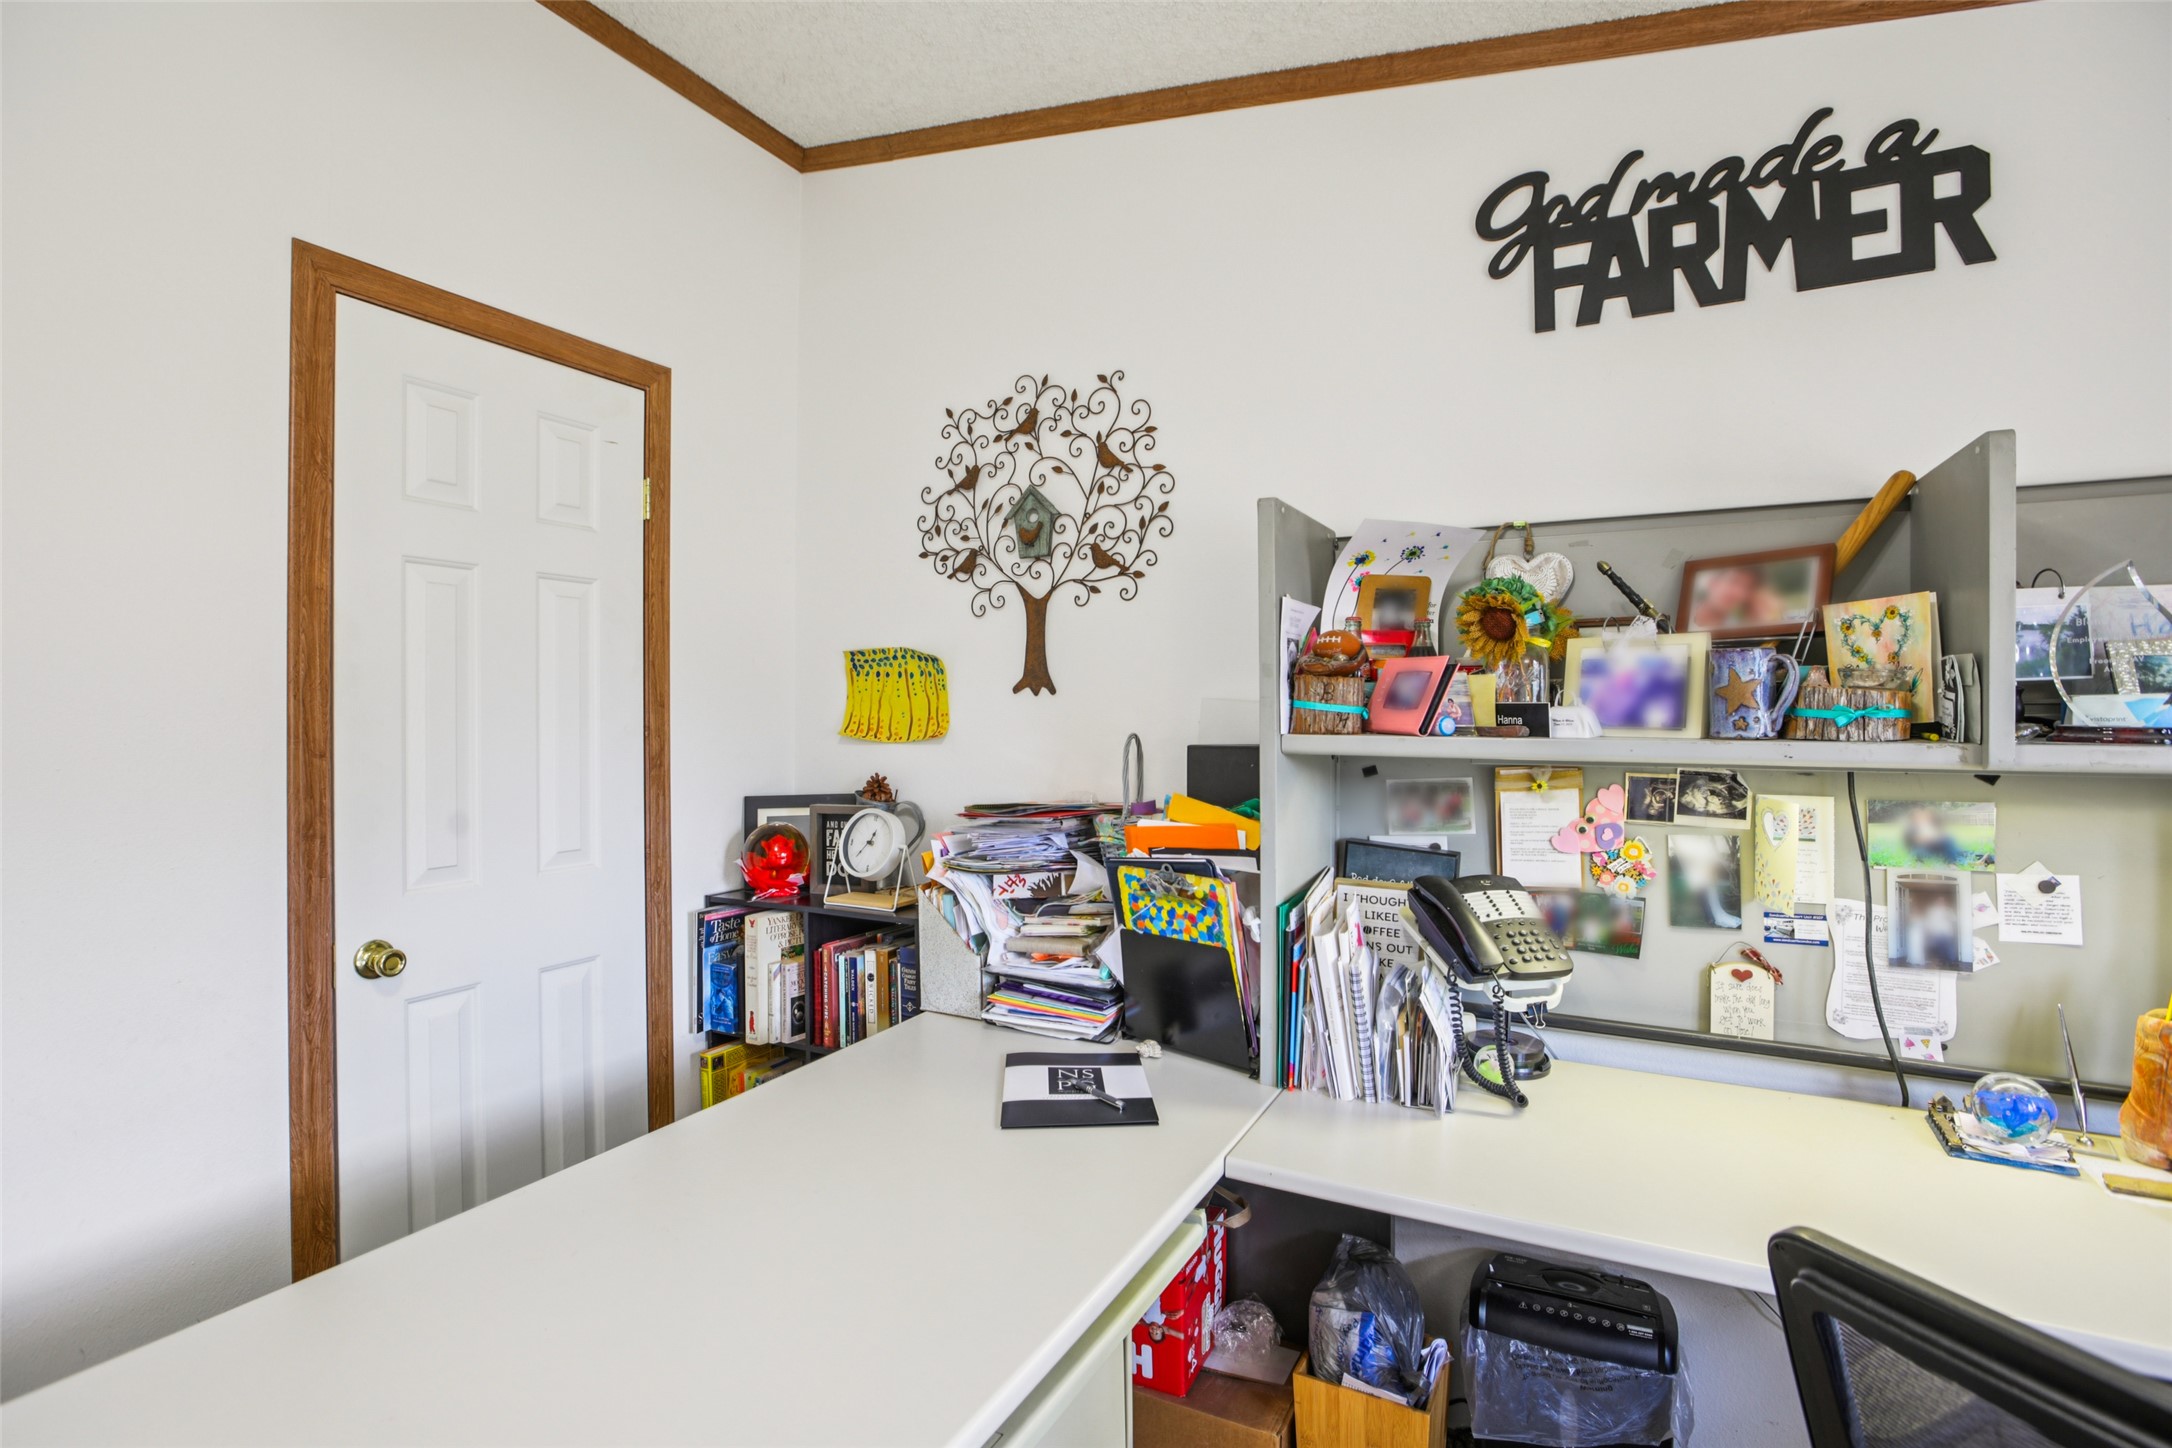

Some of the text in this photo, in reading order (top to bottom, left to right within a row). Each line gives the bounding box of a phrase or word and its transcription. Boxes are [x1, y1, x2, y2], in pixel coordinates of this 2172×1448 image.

[1628, 107, 1846, 217] made
[1864, 118, 1940, 165] a
[1533, 144, 1997, 333] FARMER
[1497, 715, 1523, 725] Hanna
[2089, 714, 2127, 724] vistaprint
[1343, 893, 1408, 907] I HOUGH
[710, 916, 741, 934] Taste
[716, 930, 739, 943] Home
[1363, 926, 1400, 938] OFFEE
[1386, 943, 1413, 955] OUT
[1728, 983, 1743, 991] sure
[1715, 993, 1731, 1004] make
[1759, 995, 1771, 1009] long
[1743, 1006, 1755, 1018] you
[1719, 1012, 1733, 1025] get
[1747, 1017, 1766, 1027] work
[1213, 1213, 1225, 1316] HUGGI
